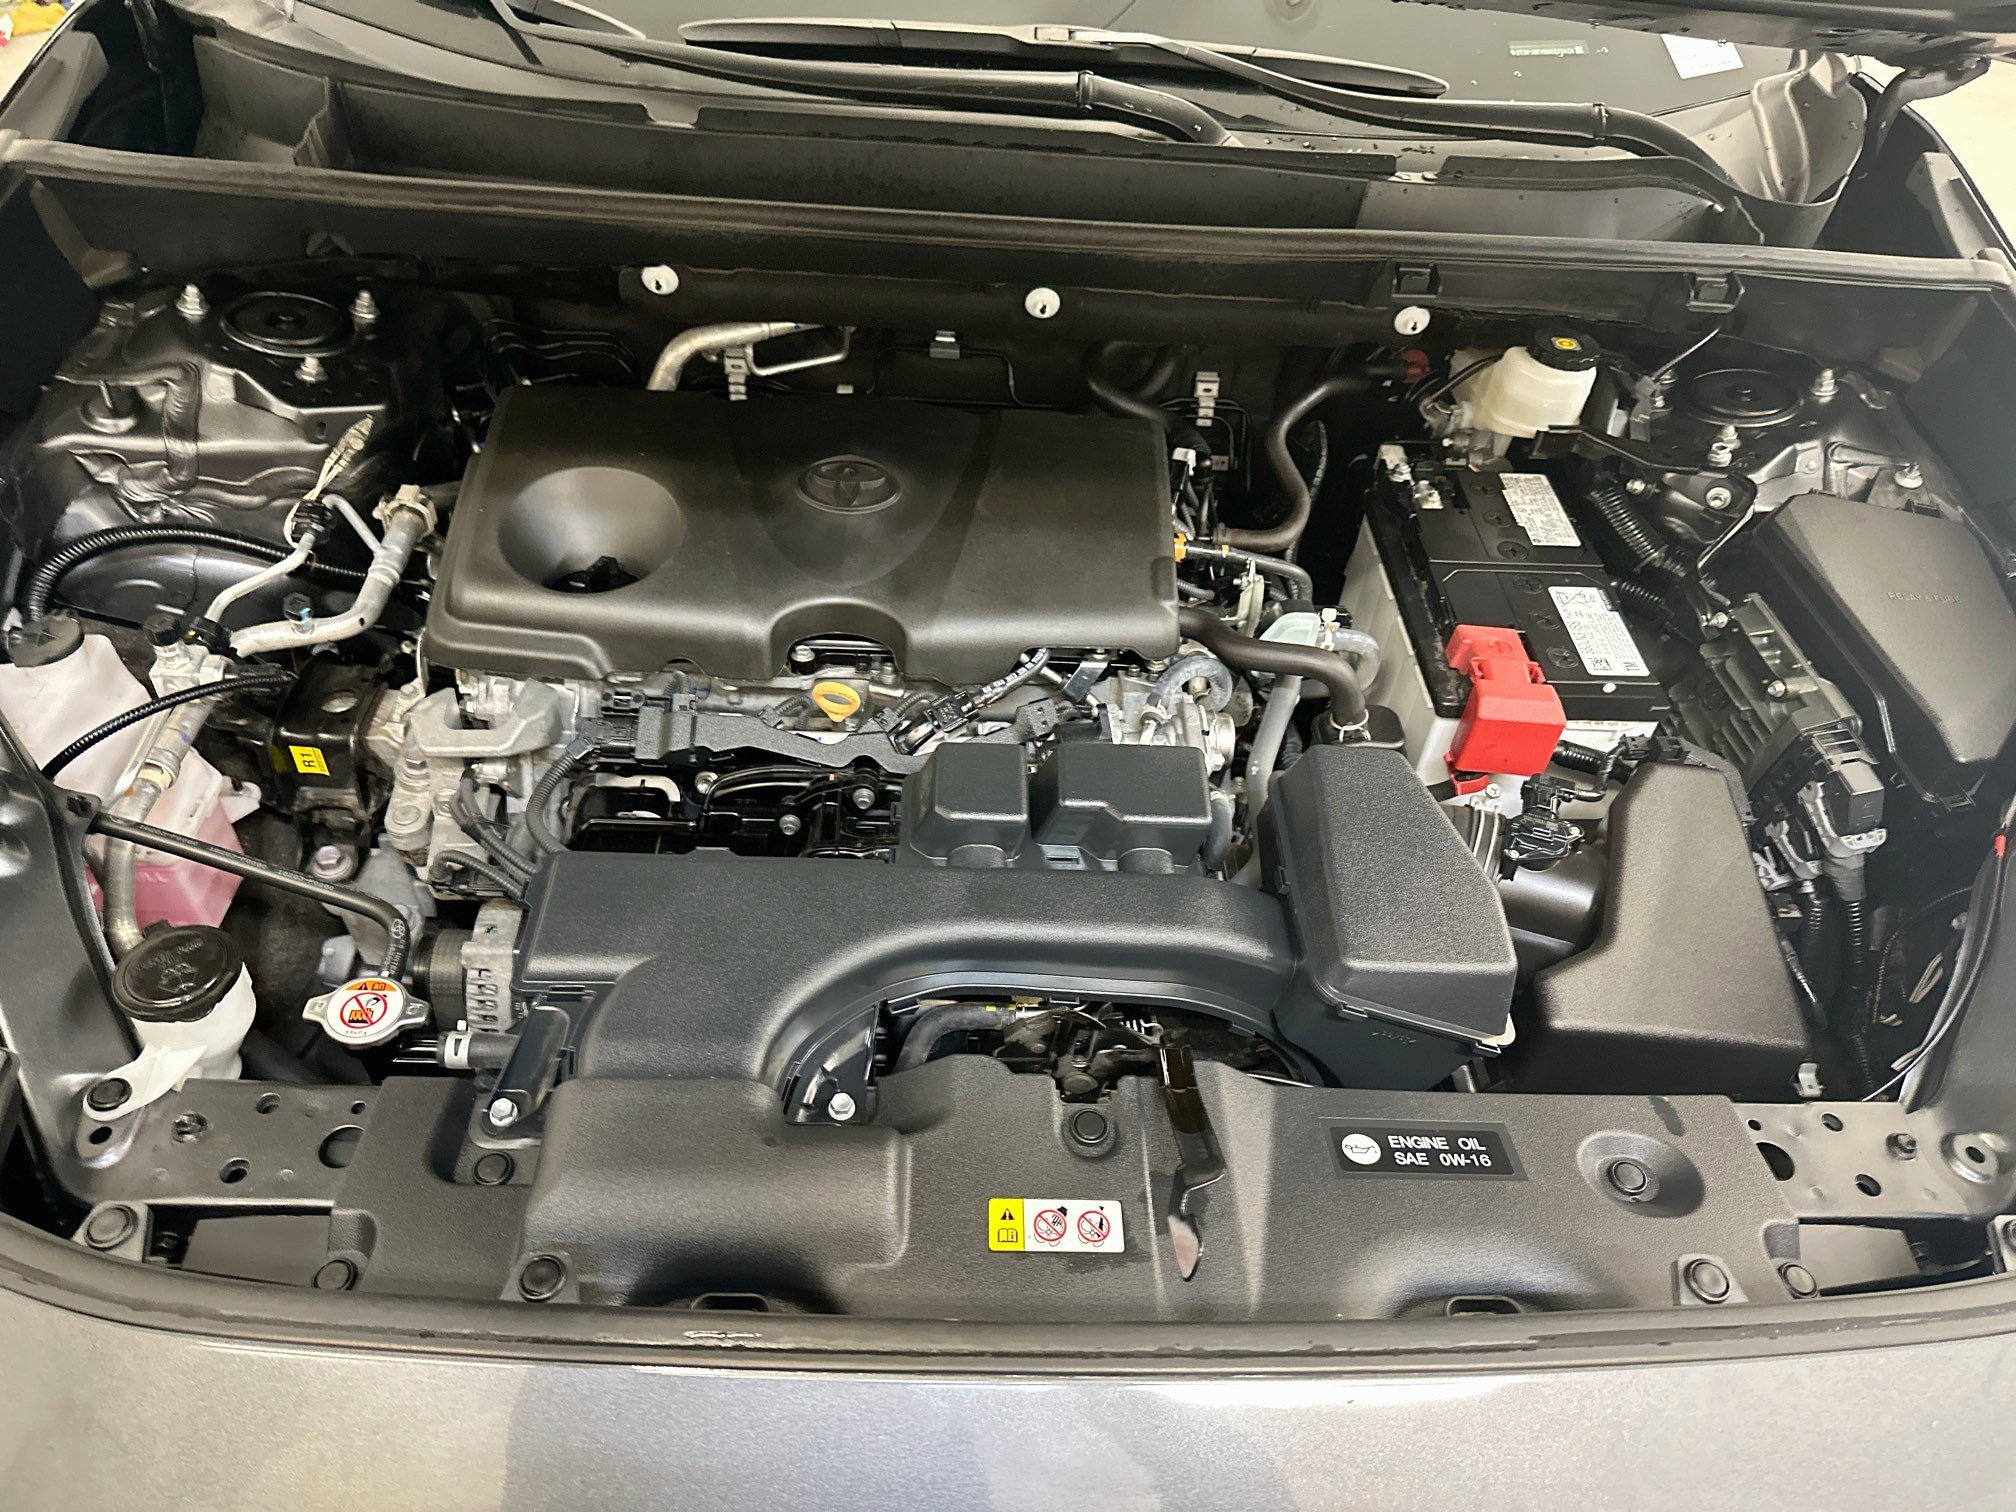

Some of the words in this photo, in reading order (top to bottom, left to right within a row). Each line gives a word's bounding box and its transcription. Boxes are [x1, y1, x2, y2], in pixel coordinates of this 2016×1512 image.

[1387, 1135, 1450, 1150] ENGINE
[1457, 1137, 1487, 1151] OIL
[1394, 1152, 1430, 1166] SAE
[1438, 1153, 1492, 1167] 0W-16
